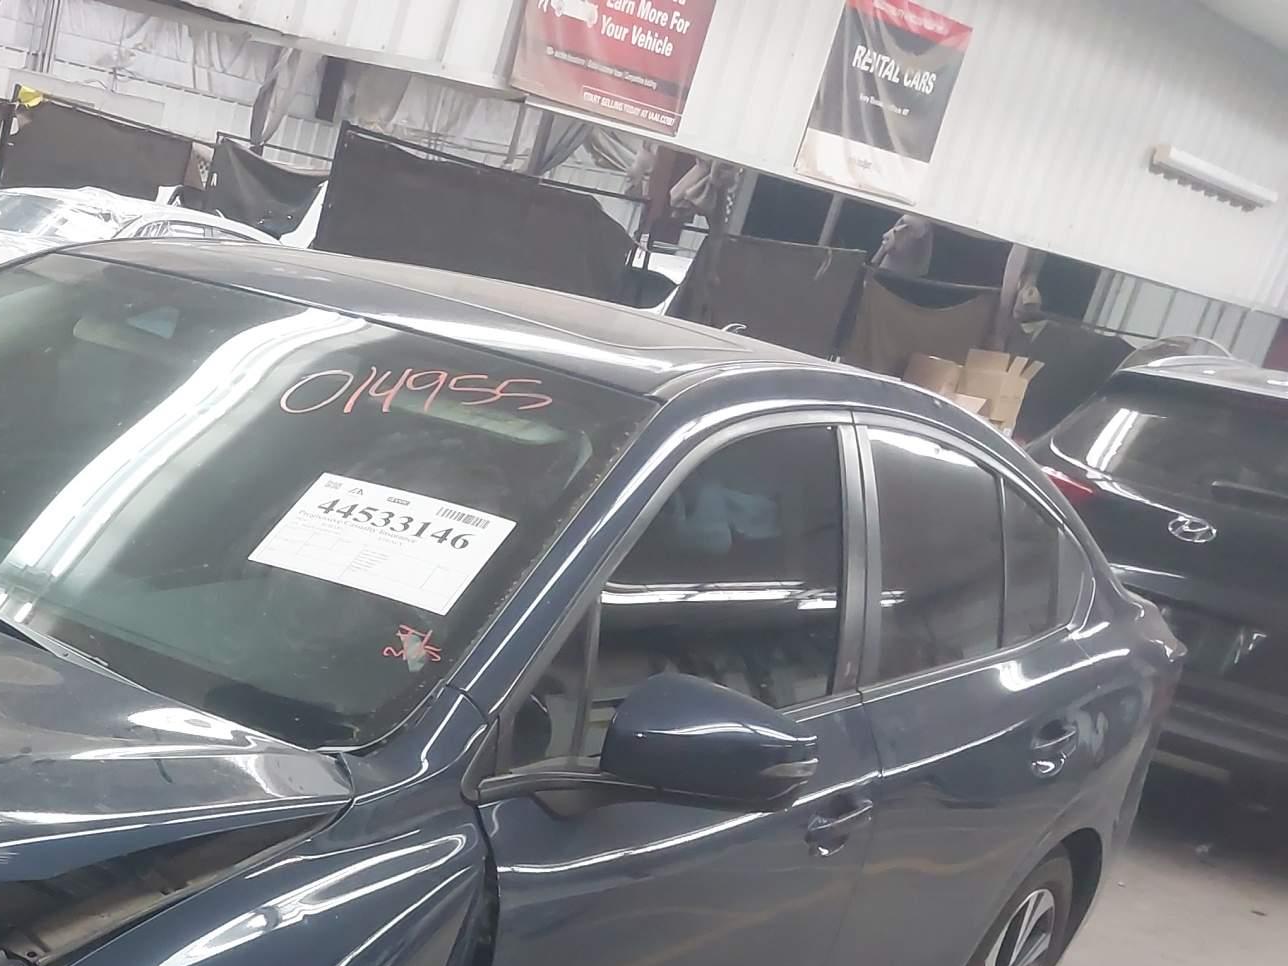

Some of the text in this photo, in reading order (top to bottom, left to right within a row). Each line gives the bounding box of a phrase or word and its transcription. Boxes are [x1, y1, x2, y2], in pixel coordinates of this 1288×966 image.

[601, 14, 674, 57] Your Vehicle
[637, 0, 669, 26] More
[669, 11, 691, 34] For
[852, 45, 937, 95] RENTAL CARS
[279, 366, 553, 414] 014955
[317, 498, 471, 550] 44533146
